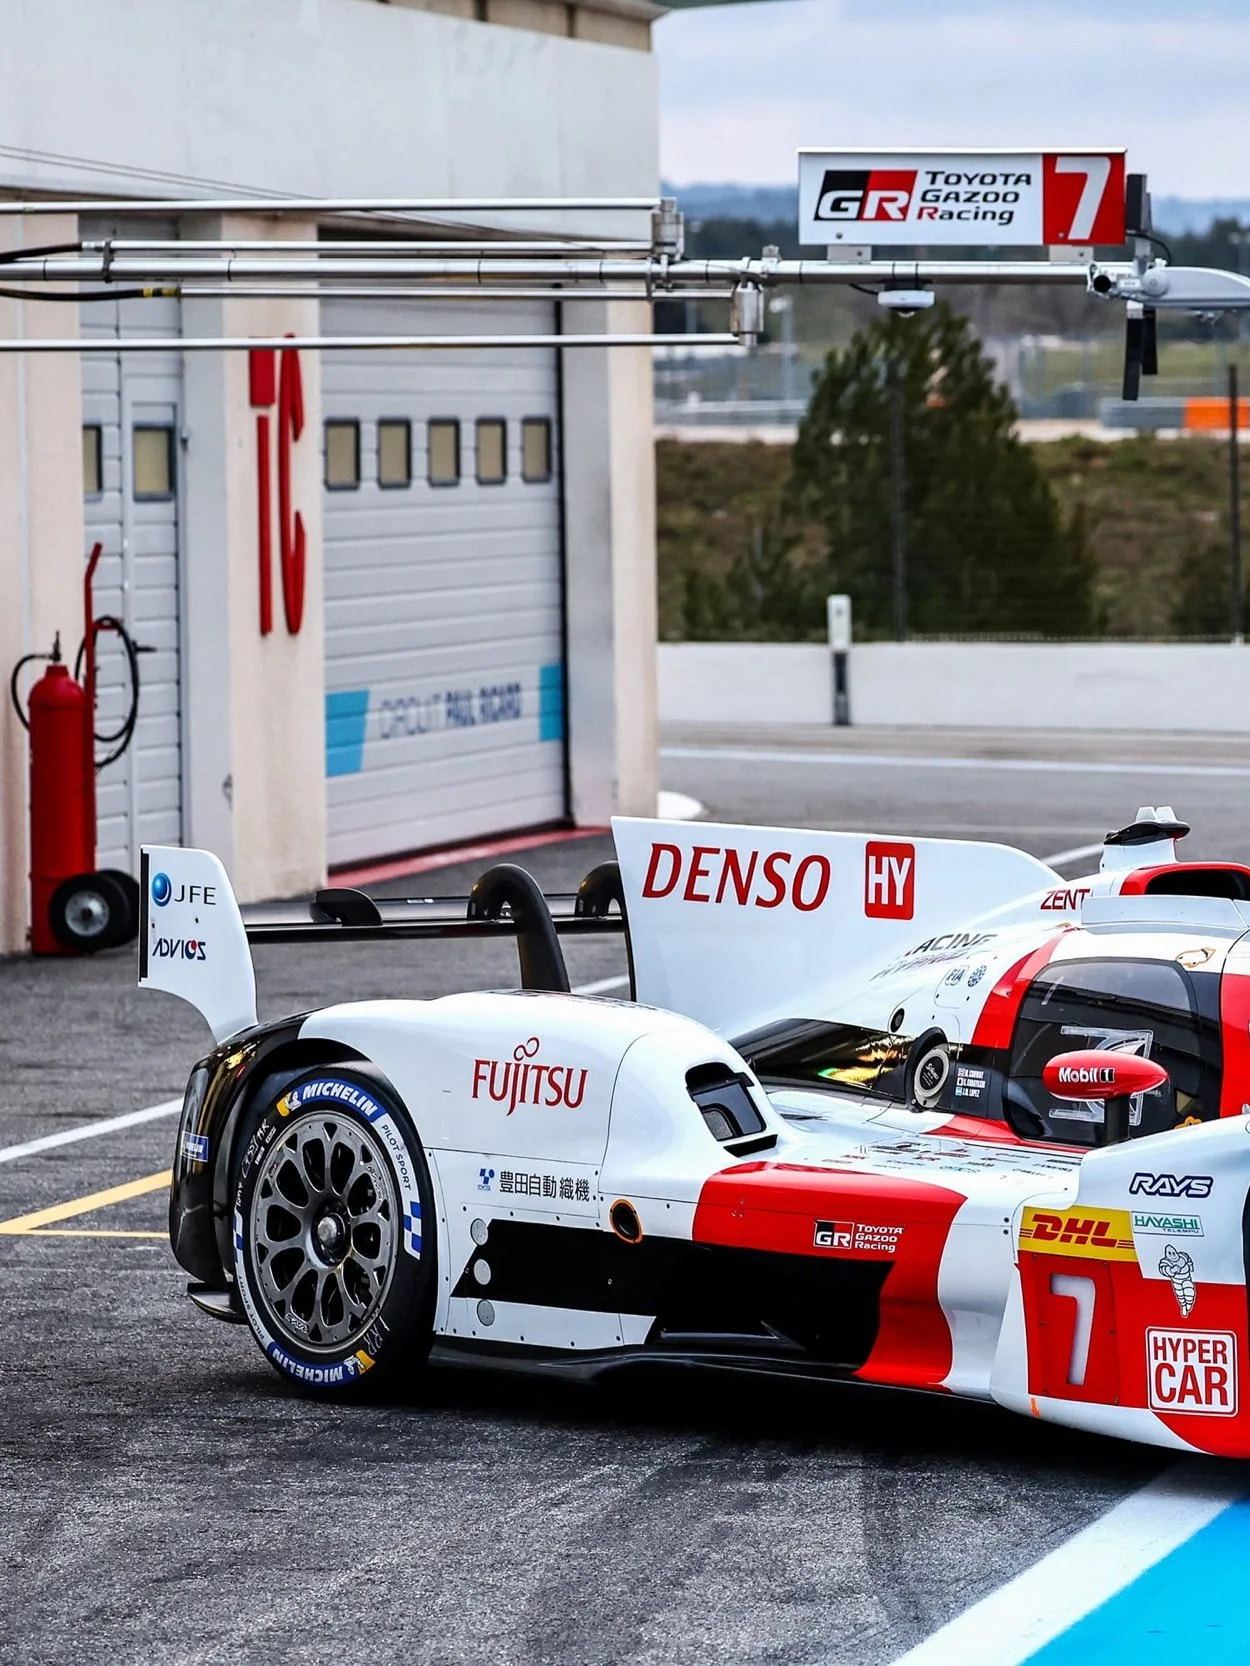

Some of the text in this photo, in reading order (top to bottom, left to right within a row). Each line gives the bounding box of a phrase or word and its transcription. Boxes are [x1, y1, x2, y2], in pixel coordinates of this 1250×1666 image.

[925, 171, 1031, 186] TOYOTA
[817, 190, 909, 220] GR
[921, 189, 1019, 203] GAZOO
[1054, 157, 1111, 240] 7
[917, 206, 1014, 225] Racing
[642, 843, 831, 911] DENSO
[868, 855, 911, 906] HY
[174, 885, 216, 905] JFE
[1040, 889, 1090, 910] ZENT
[152, 938, 206, 960] ADVICS
[472, 1058, 588, 1116] FUJITSU
[1058, 1067, 1098, 1083] Mobil
[302, 1082, 378, 1117] MICHELIN
[381, 1124, 412, 1191] PILOT SPORT
[499, 1171, 590, 1201] 豊田自動織機
[1130, 1174, 1213, 1197] RAYS
[856, 1224, 904, 1235] TOYOTA
[1032, 1213, 1118, 1248] DHL
[1134, 1215, 1200, 1229] HAYASHI
[816, 1231, 850, 1247] GR
[854, 1241, 896, 1253] Racing
[855, 1232, 897, 1242] GAZOO
[250, 1313, 265, 1340] PILOT
[1051, 1273, 1096, 1386] 7
[1153, 1336, 1228, 1364] HYPER
[272, 1348, 343, 1382] MICHELIN
[1154, 1363, 1229, 1406] CAR
